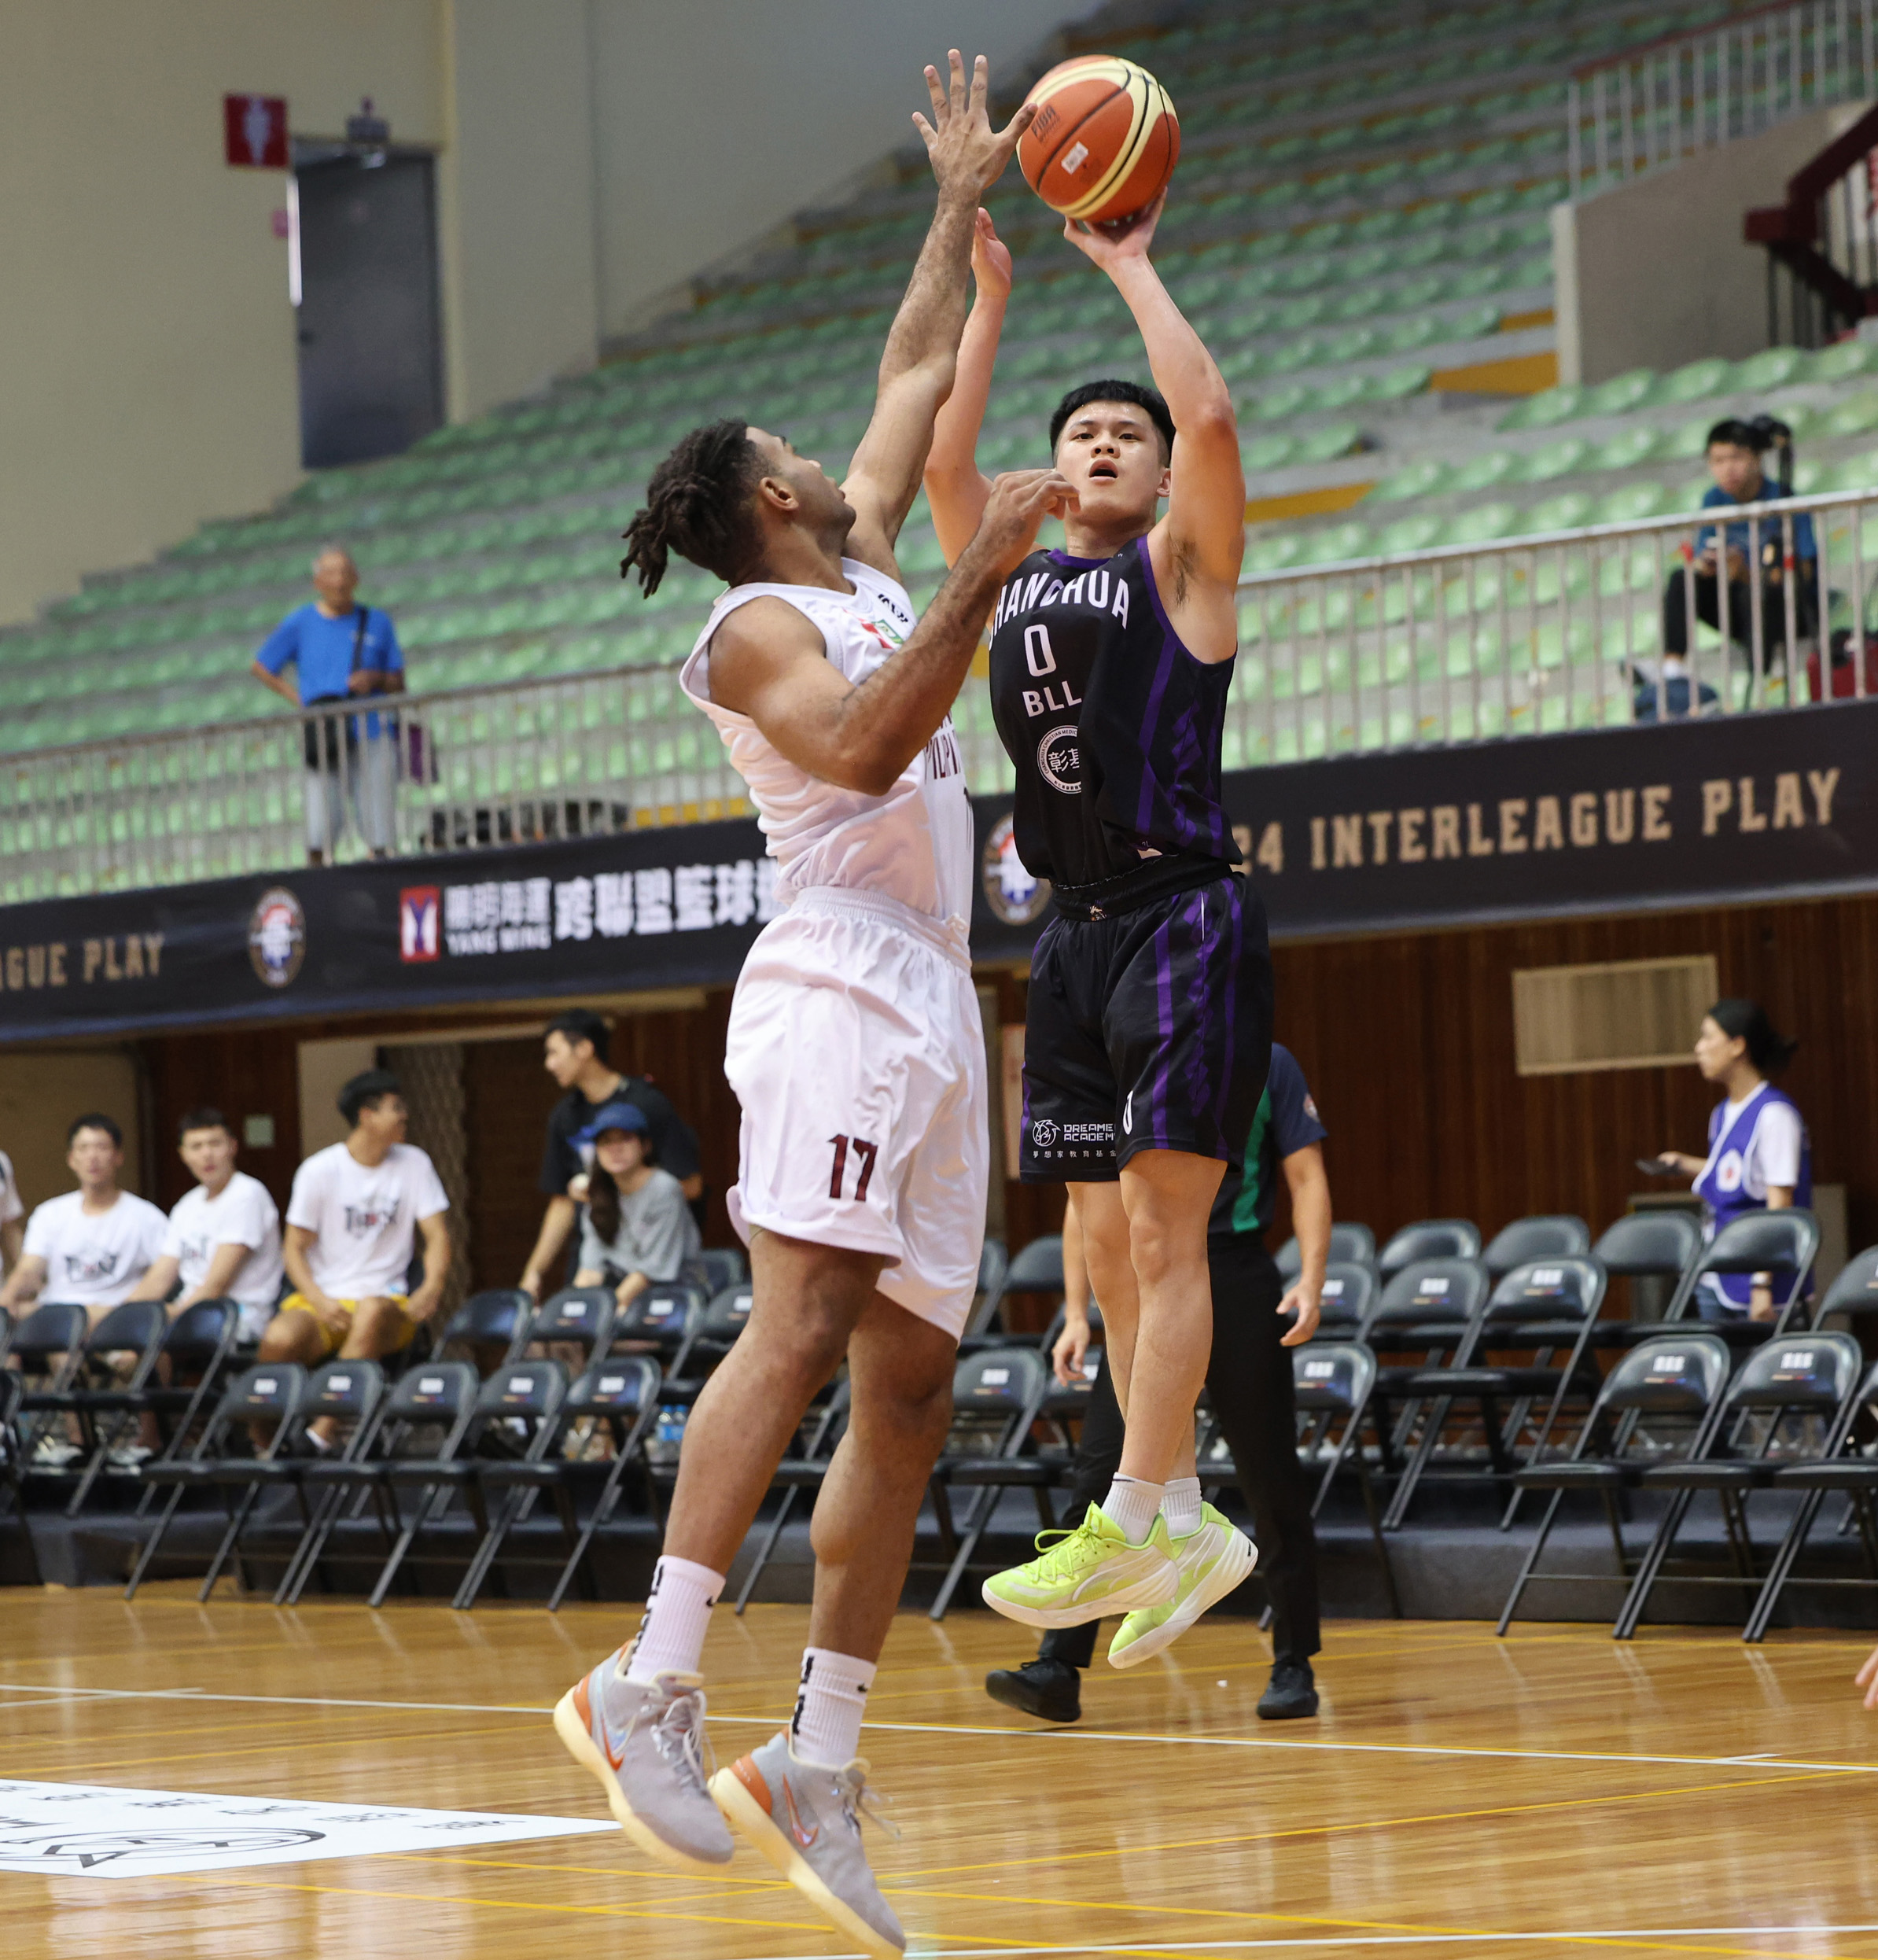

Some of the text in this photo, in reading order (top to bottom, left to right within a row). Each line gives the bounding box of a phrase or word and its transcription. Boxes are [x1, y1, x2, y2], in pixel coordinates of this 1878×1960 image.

[1024, 624, 1057, 677] 0
[1022, 680, 1082, 717] BLL
[1043, 730, 1062, 749] CHRISTIAN
[1040, 746, 1050, 774] CHANGHUA
[1311, 787, 1672, 871] INTERLEAGUE
[1701, 767, 1843, 837] PLAY
[0, 933, 164, 991] GUE PLAY
[1063, 1123, 1115, 1133] DREAME
[1063, 1133, 1115, 1142] ACADEM
[827, 1133, 878, 1202] 17
